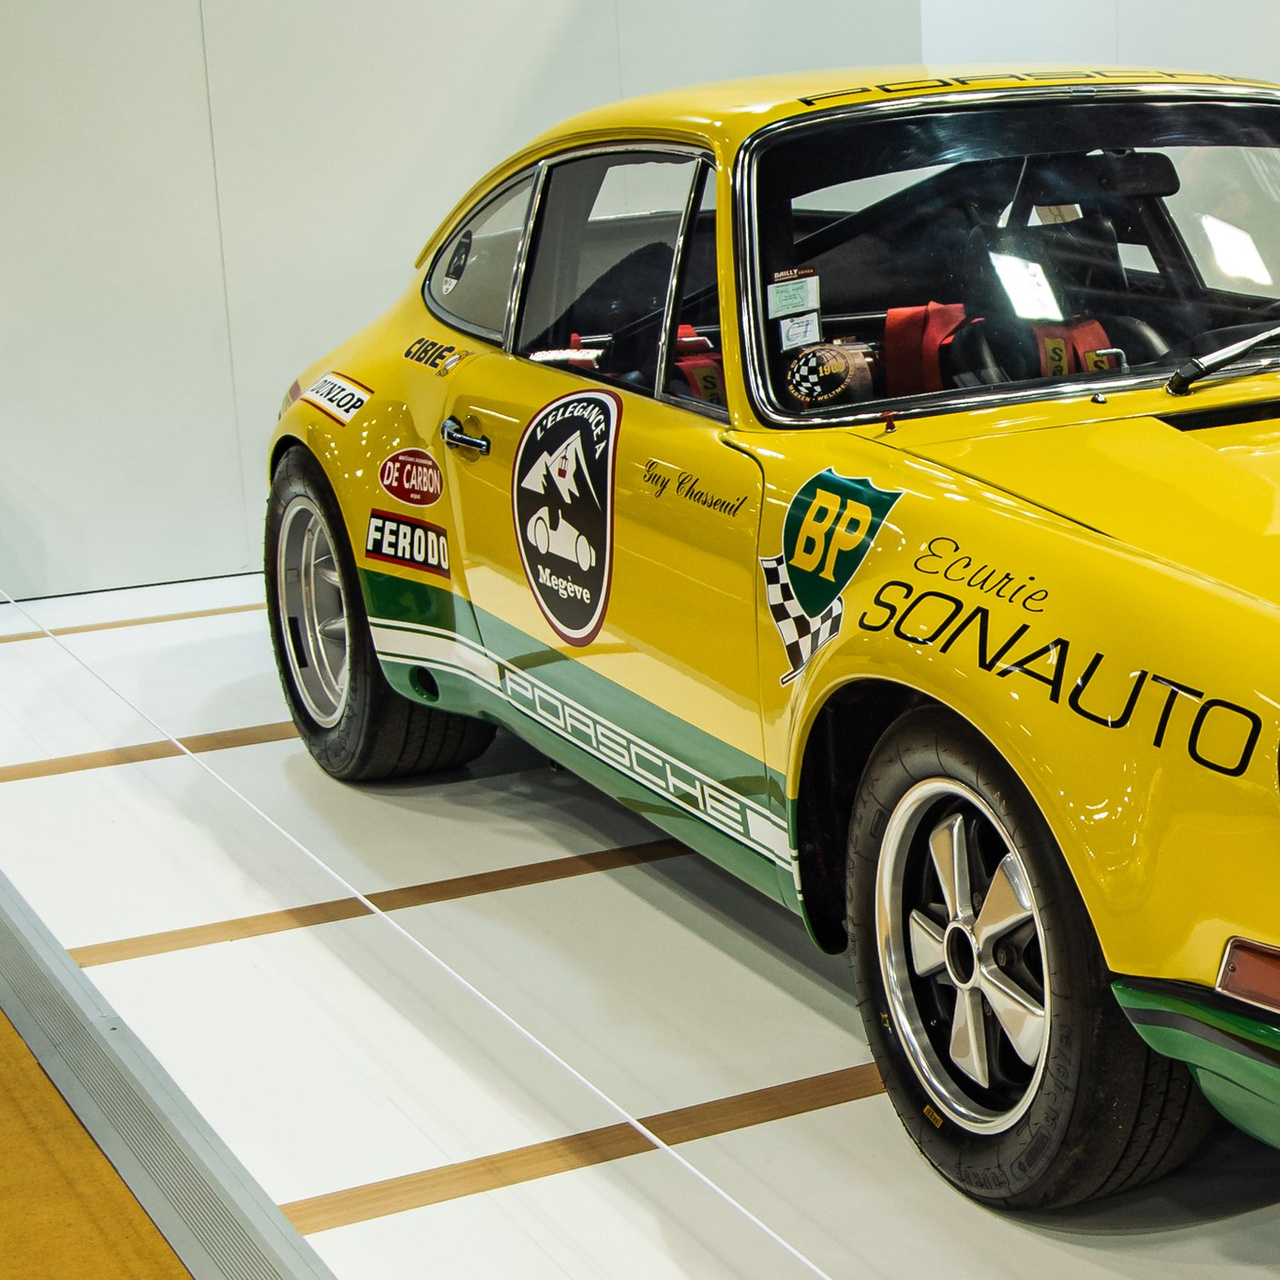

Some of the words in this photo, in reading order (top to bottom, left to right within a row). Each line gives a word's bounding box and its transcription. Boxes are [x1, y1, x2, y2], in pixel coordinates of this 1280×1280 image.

[310, 379, 365, 415] DUNLOP
[383, 460, 401, 487] DE
[403, 464, 441, 494] CARBON
[643, 459, 671, 498] Guy
[366, 517, 449, 570] FERODO
[788, 486, 872, 584] BP
[537, 564, 592, 605] Megève
[914, 536, 1051, 613] Ecurie
[858, 580, 1263, 778] SONAUTO
[504, 668, 745, 835] PORSCHE
